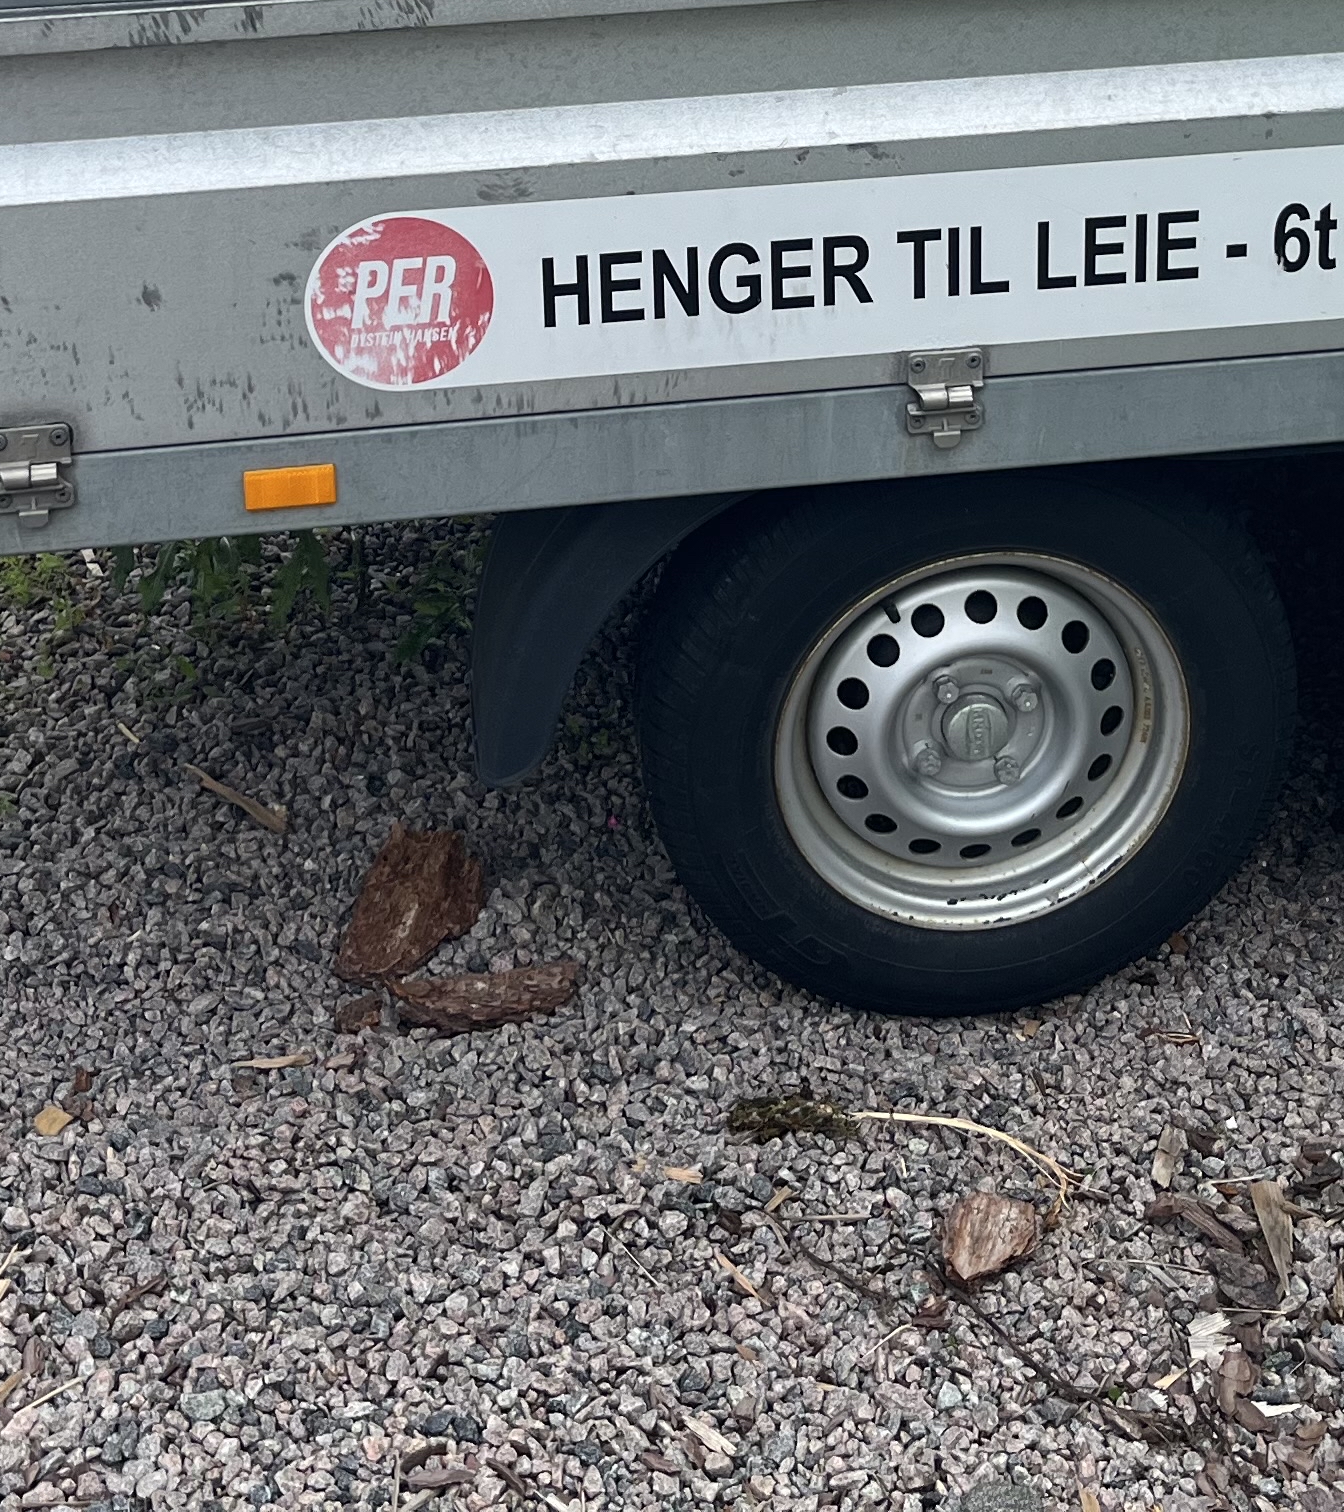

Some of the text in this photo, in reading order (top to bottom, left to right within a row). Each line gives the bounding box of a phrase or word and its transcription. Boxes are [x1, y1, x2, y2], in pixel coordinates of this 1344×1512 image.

[351, 255, 457, 330] PER
[541, 235, 874, 328] HENGER
[896, 220, 1010, 300] TIL
[1037, 209, 1200, 290] LEIE
[1225, 243, 1248, 259] -
[1273, 202, 1338, 273] 6t
